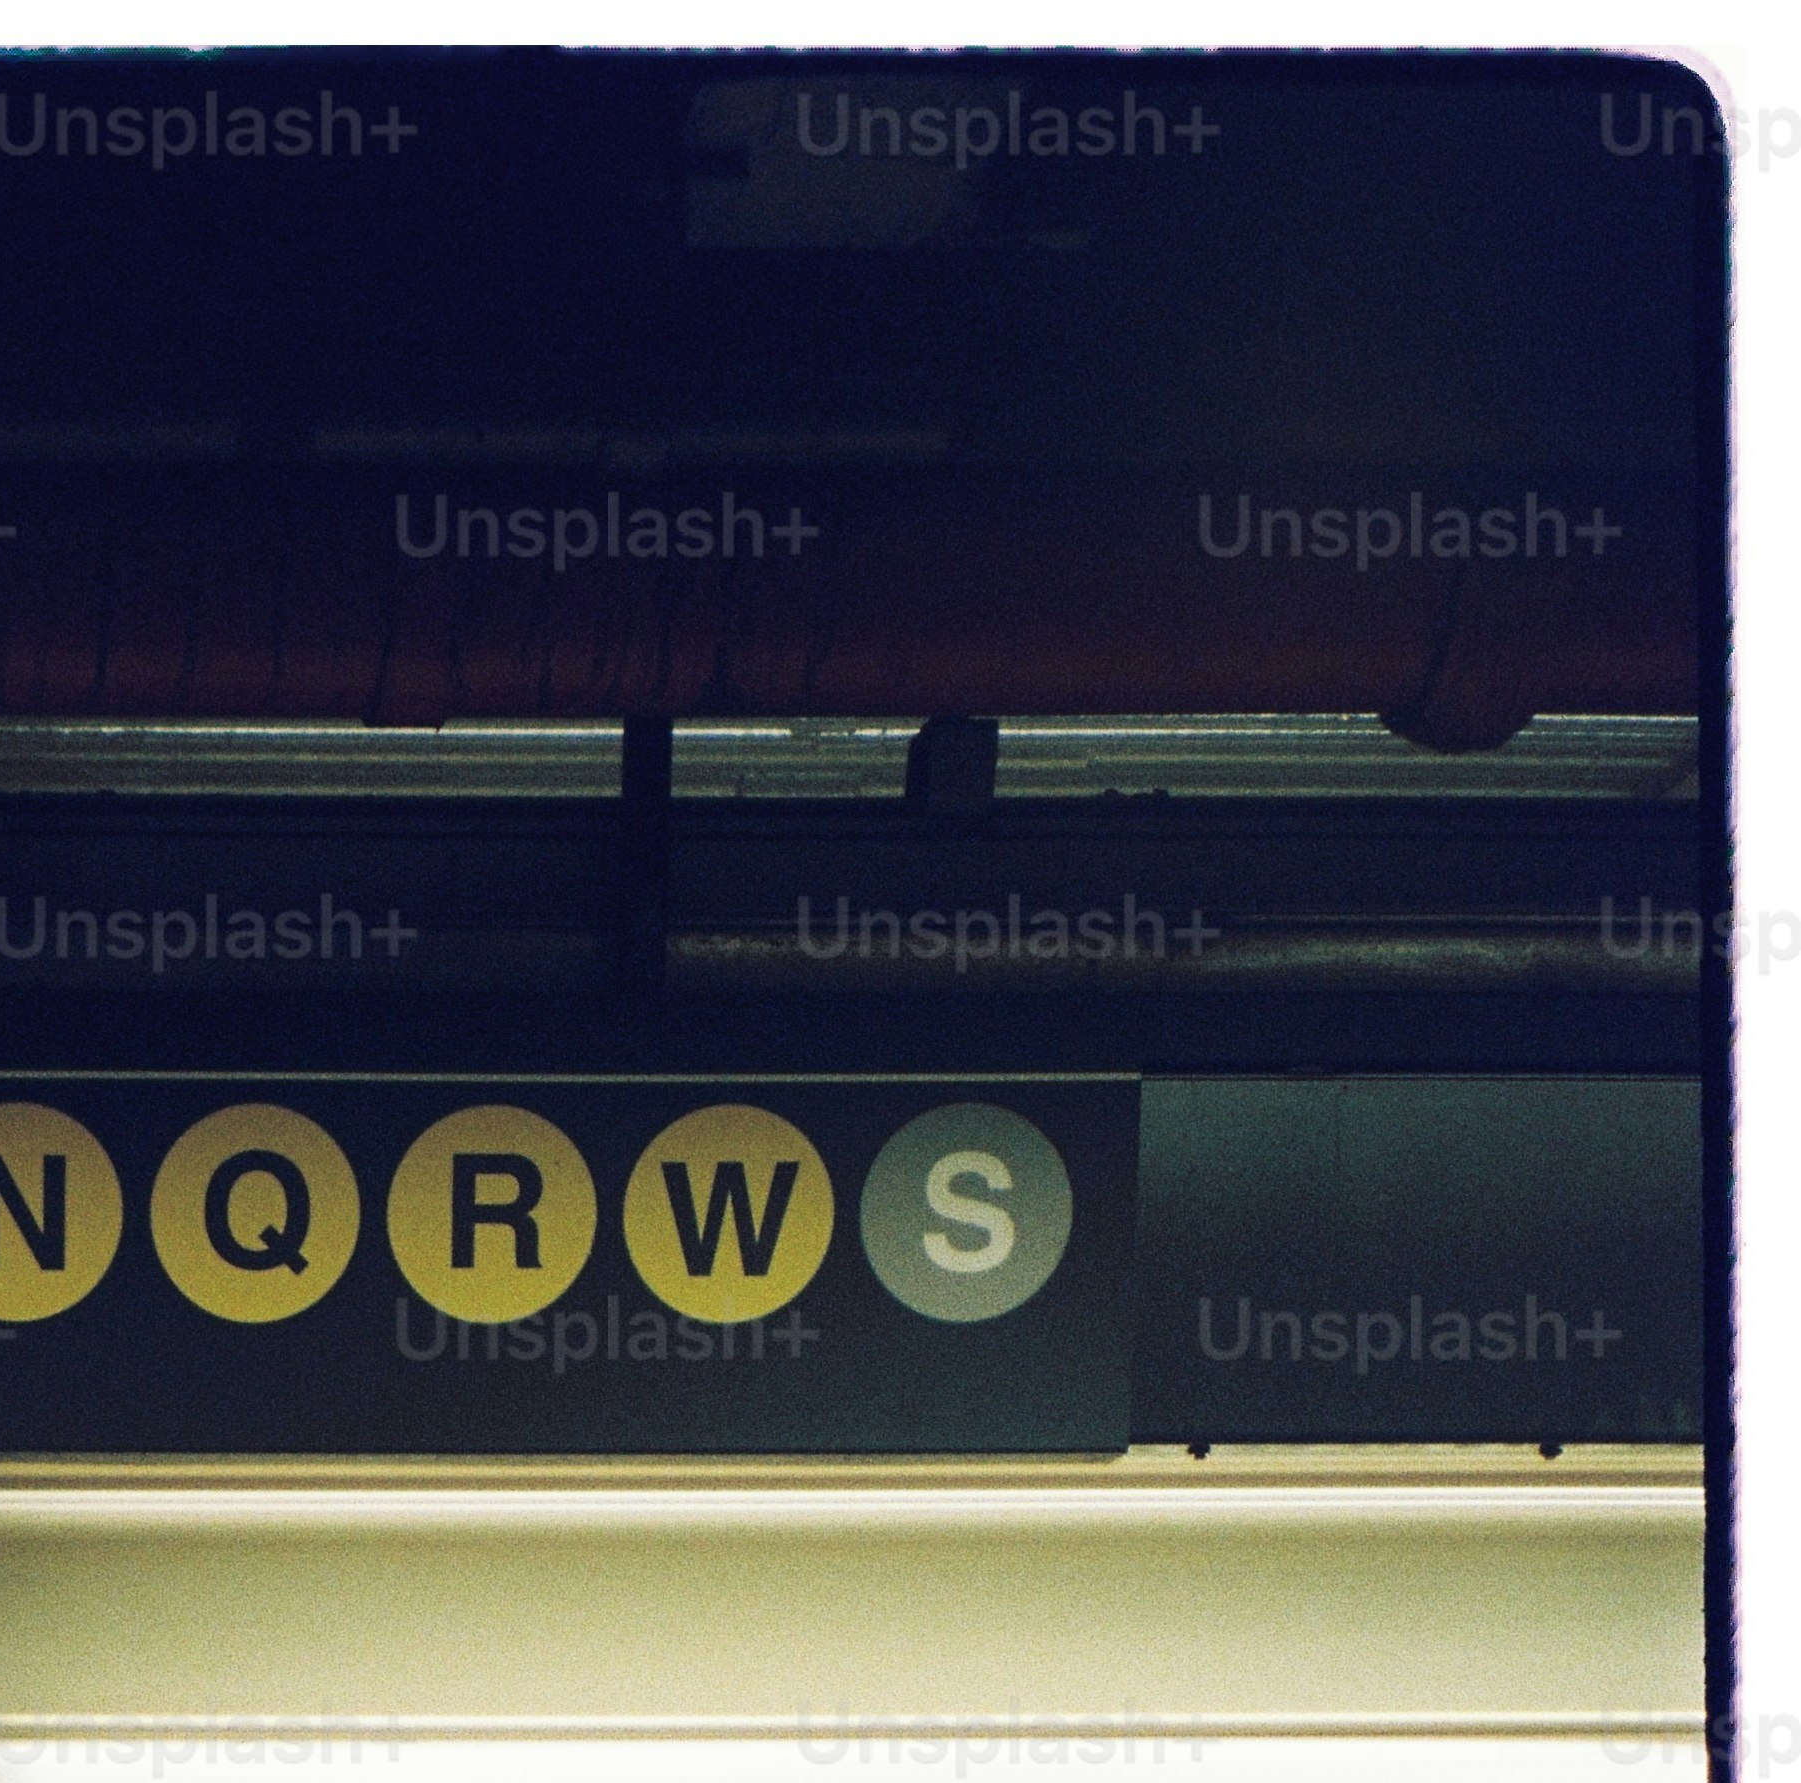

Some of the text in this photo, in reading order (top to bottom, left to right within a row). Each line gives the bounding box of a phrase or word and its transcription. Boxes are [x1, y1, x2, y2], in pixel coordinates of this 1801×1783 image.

[203, 1148, 310, 1275] Q
[451, 1152, 544, 1269] R
[659, 1160, 800, 1277] W
[921, 1151, 1017, 1277] S
